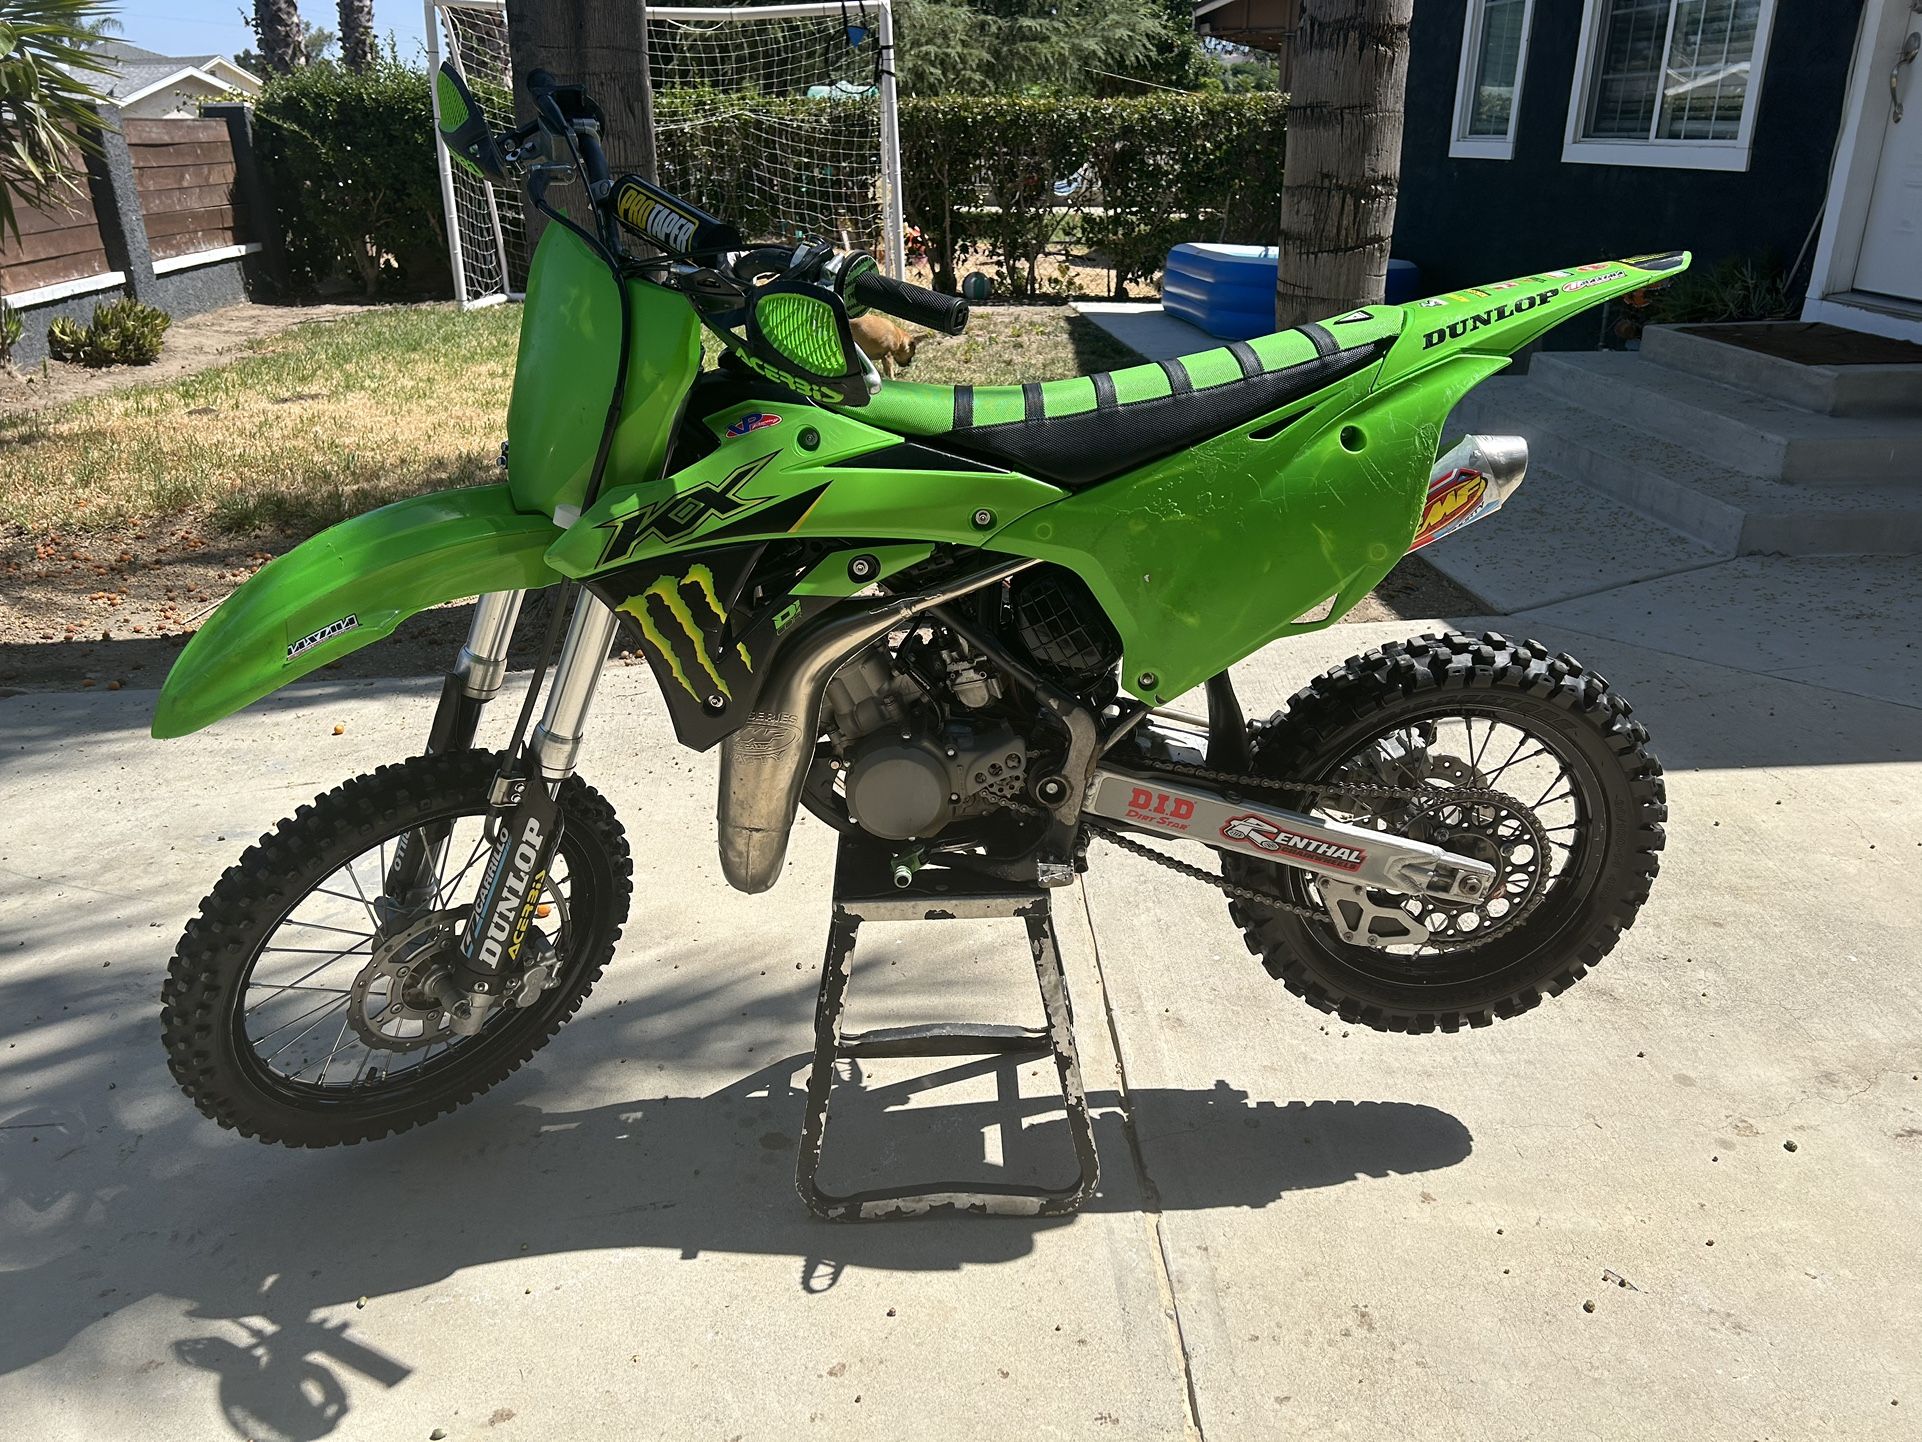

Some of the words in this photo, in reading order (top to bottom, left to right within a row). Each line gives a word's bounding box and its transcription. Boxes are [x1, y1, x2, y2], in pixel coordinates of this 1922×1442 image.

[1422, 288, 1560, 351] DUNLOP
[475, 827, 509, 913] CARRILLO
[478, 816, 545, 970] DUNLOP
